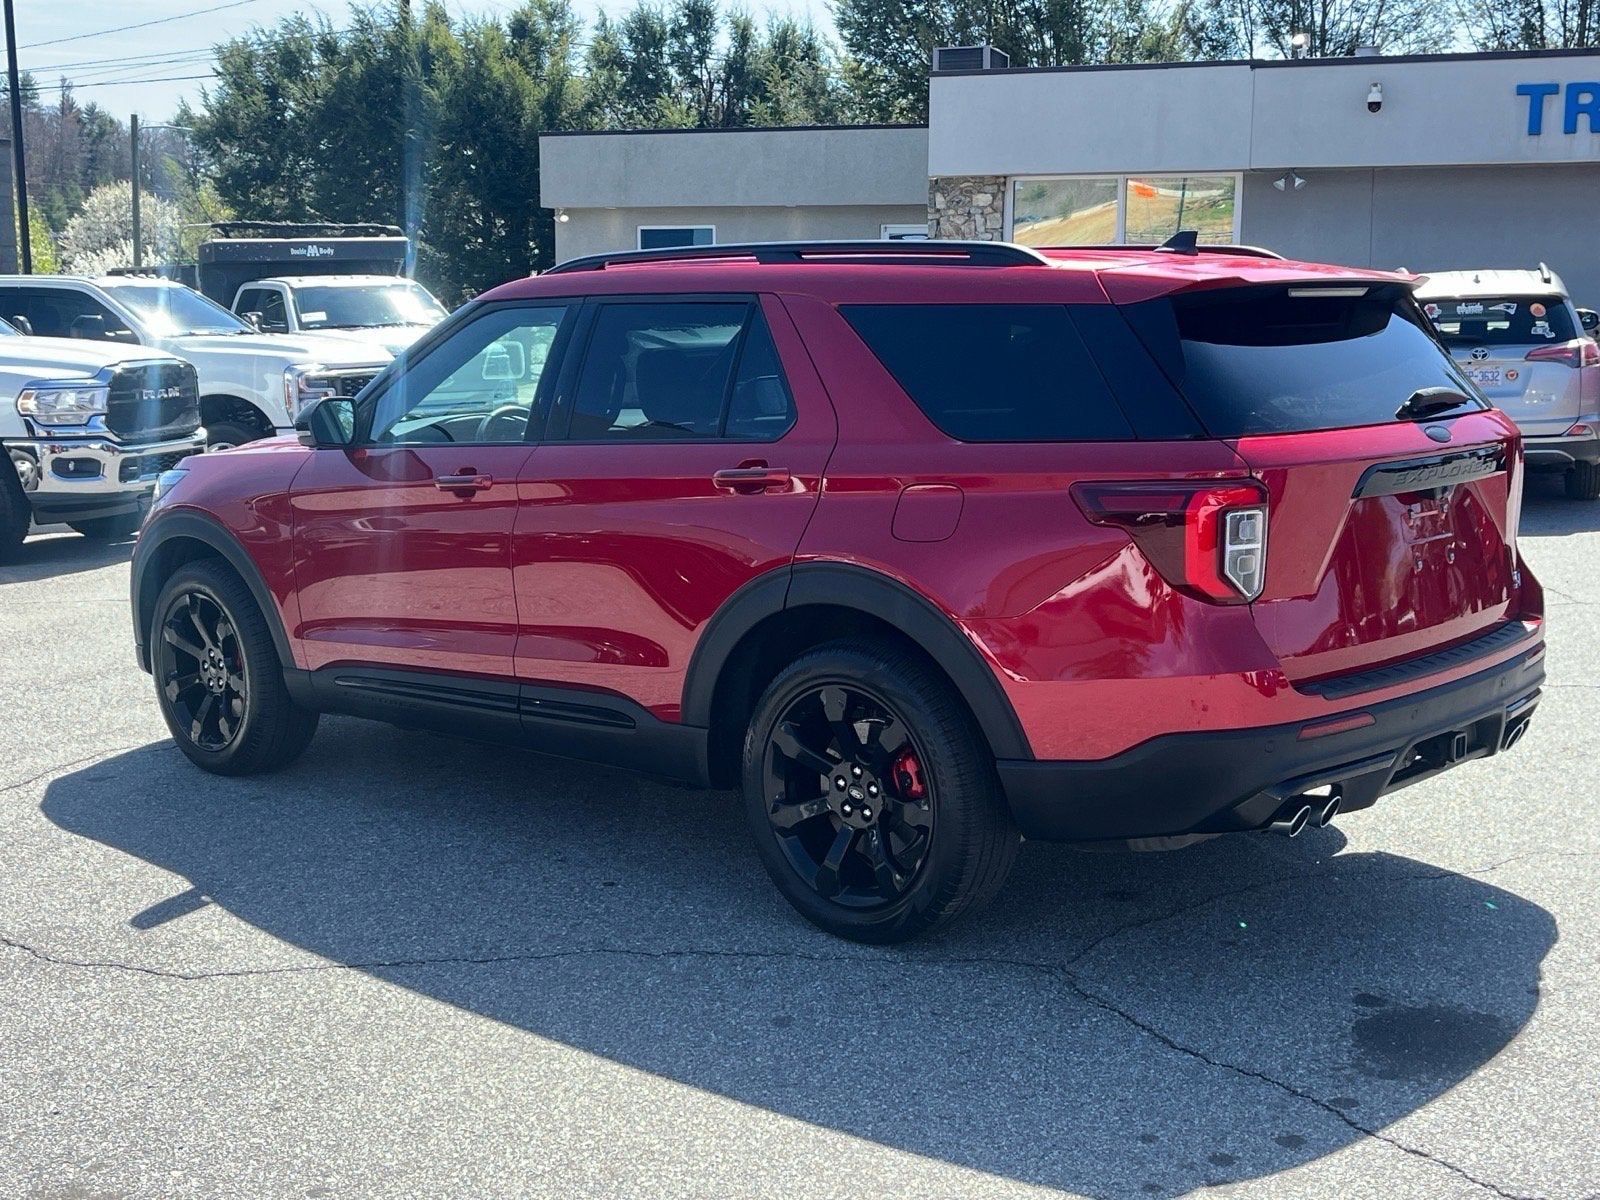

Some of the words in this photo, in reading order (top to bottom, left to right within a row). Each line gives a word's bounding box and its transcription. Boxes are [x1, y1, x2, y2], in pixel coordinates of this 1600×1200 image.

[1516, 82, 1600, 136] TR
[319, 247, 335, 256] Body
[1464, 370, 1500, 382] P-3632
[142, 386, 180, 400] RAM
[1392, 459, 1497, 486] EXPLORER
